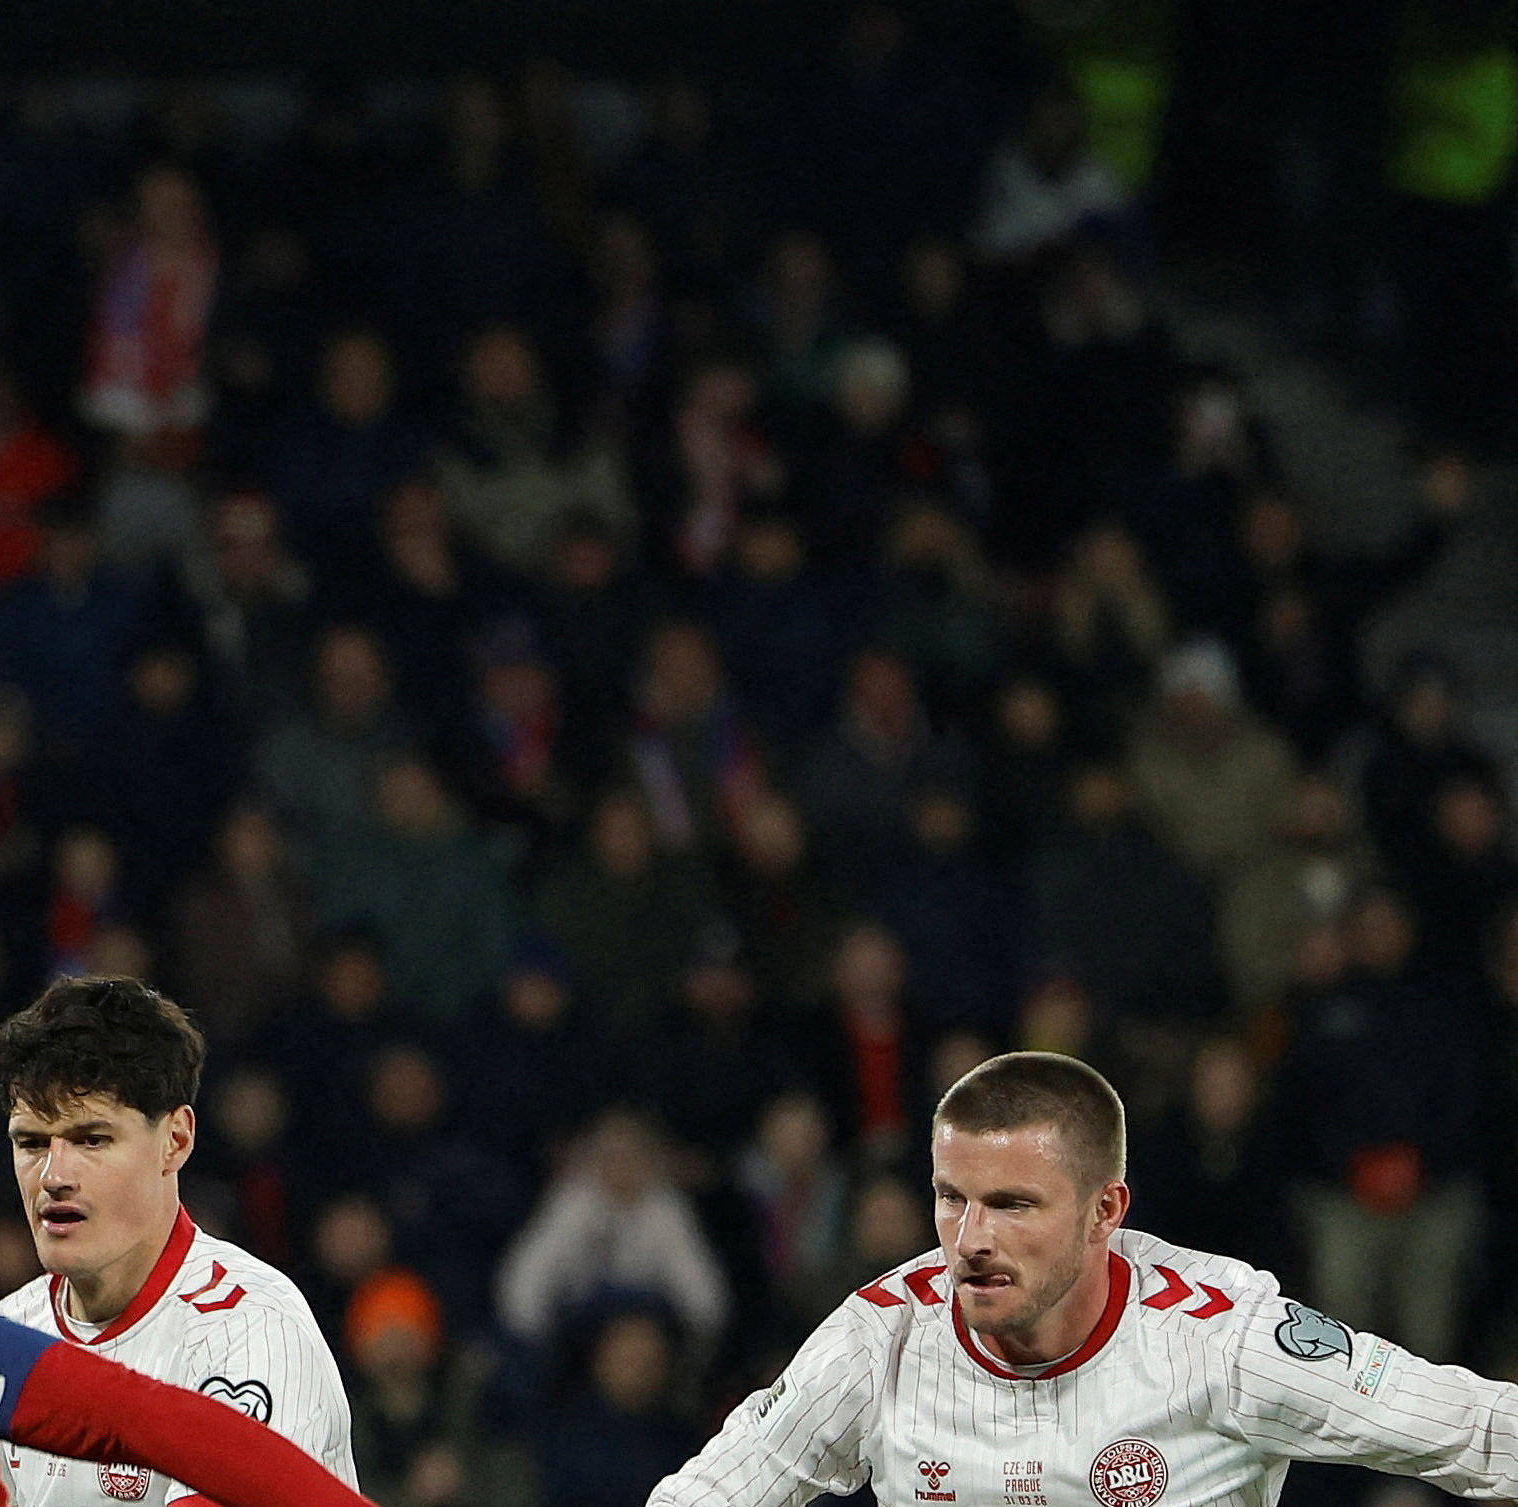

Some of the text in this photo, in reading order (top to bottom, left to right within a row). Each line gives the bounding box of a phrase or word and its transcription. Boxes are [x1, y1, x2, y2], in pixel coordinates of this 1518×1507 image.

[1106, 1461, 1153, 1490] DBU
[1005, 1478, 1042, 1493] PRAGUE
[914, 1488, 957, 1502] hummel
